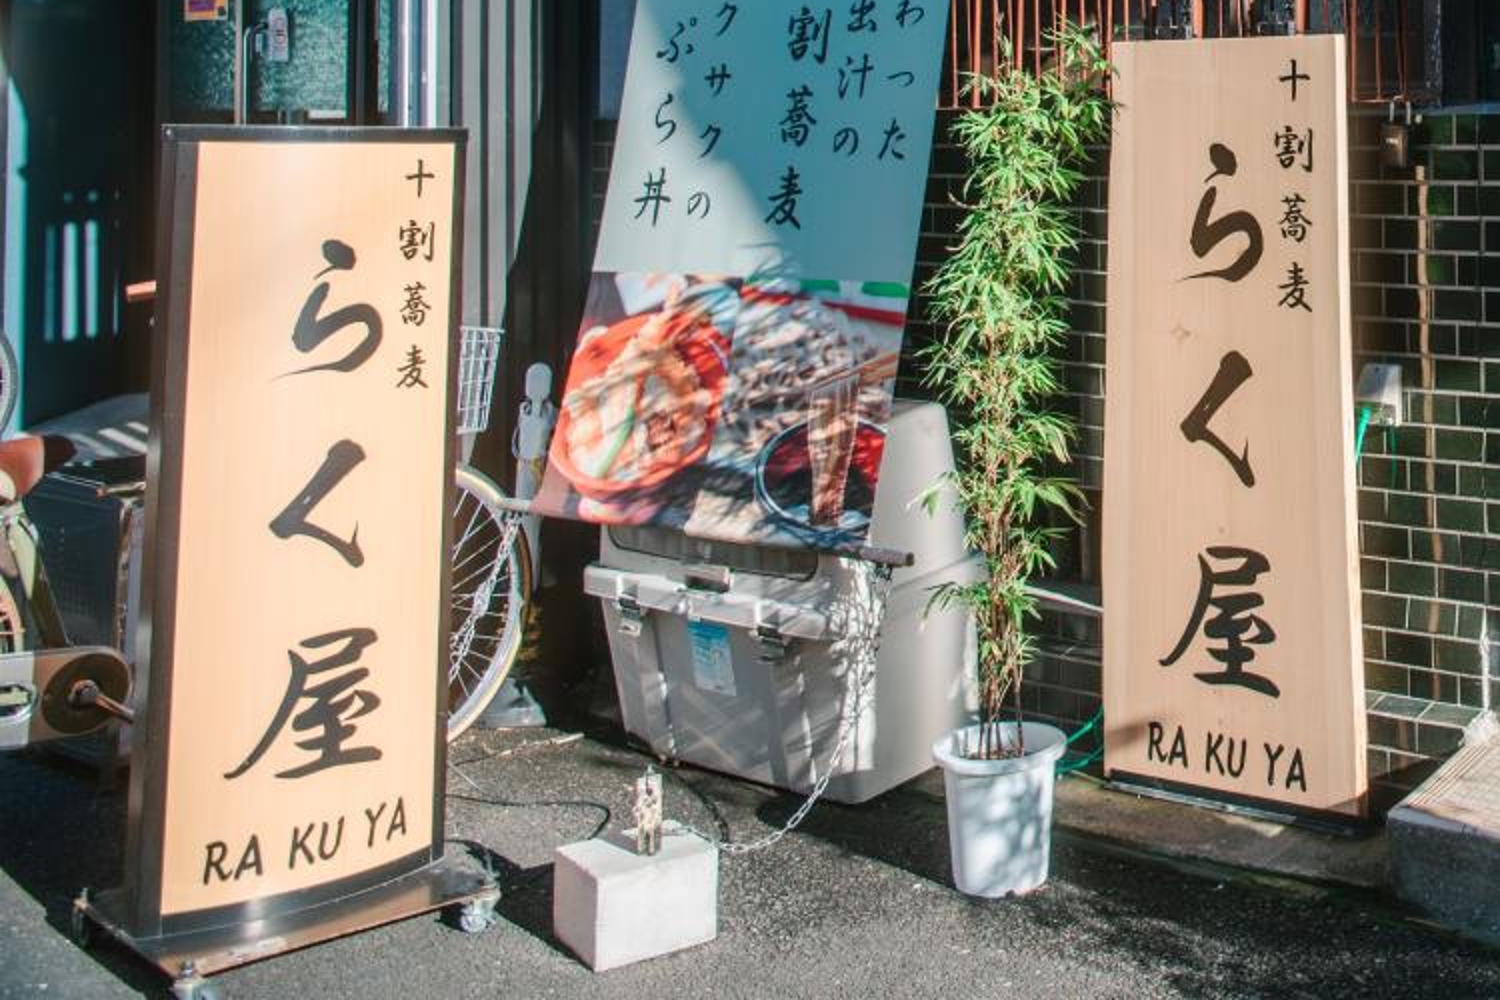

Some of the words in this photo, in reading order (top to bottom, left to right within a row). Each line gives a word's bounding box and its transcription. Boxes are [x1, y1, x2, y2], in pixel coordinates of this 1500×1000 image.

[395, 158, 436, 389] 十割蕎麦
[1272, 57, 1314, 313] 十割蕎麦
[222, 239, 384, 781] らく屋
[1157, 142, 1281, 699] らく屋
